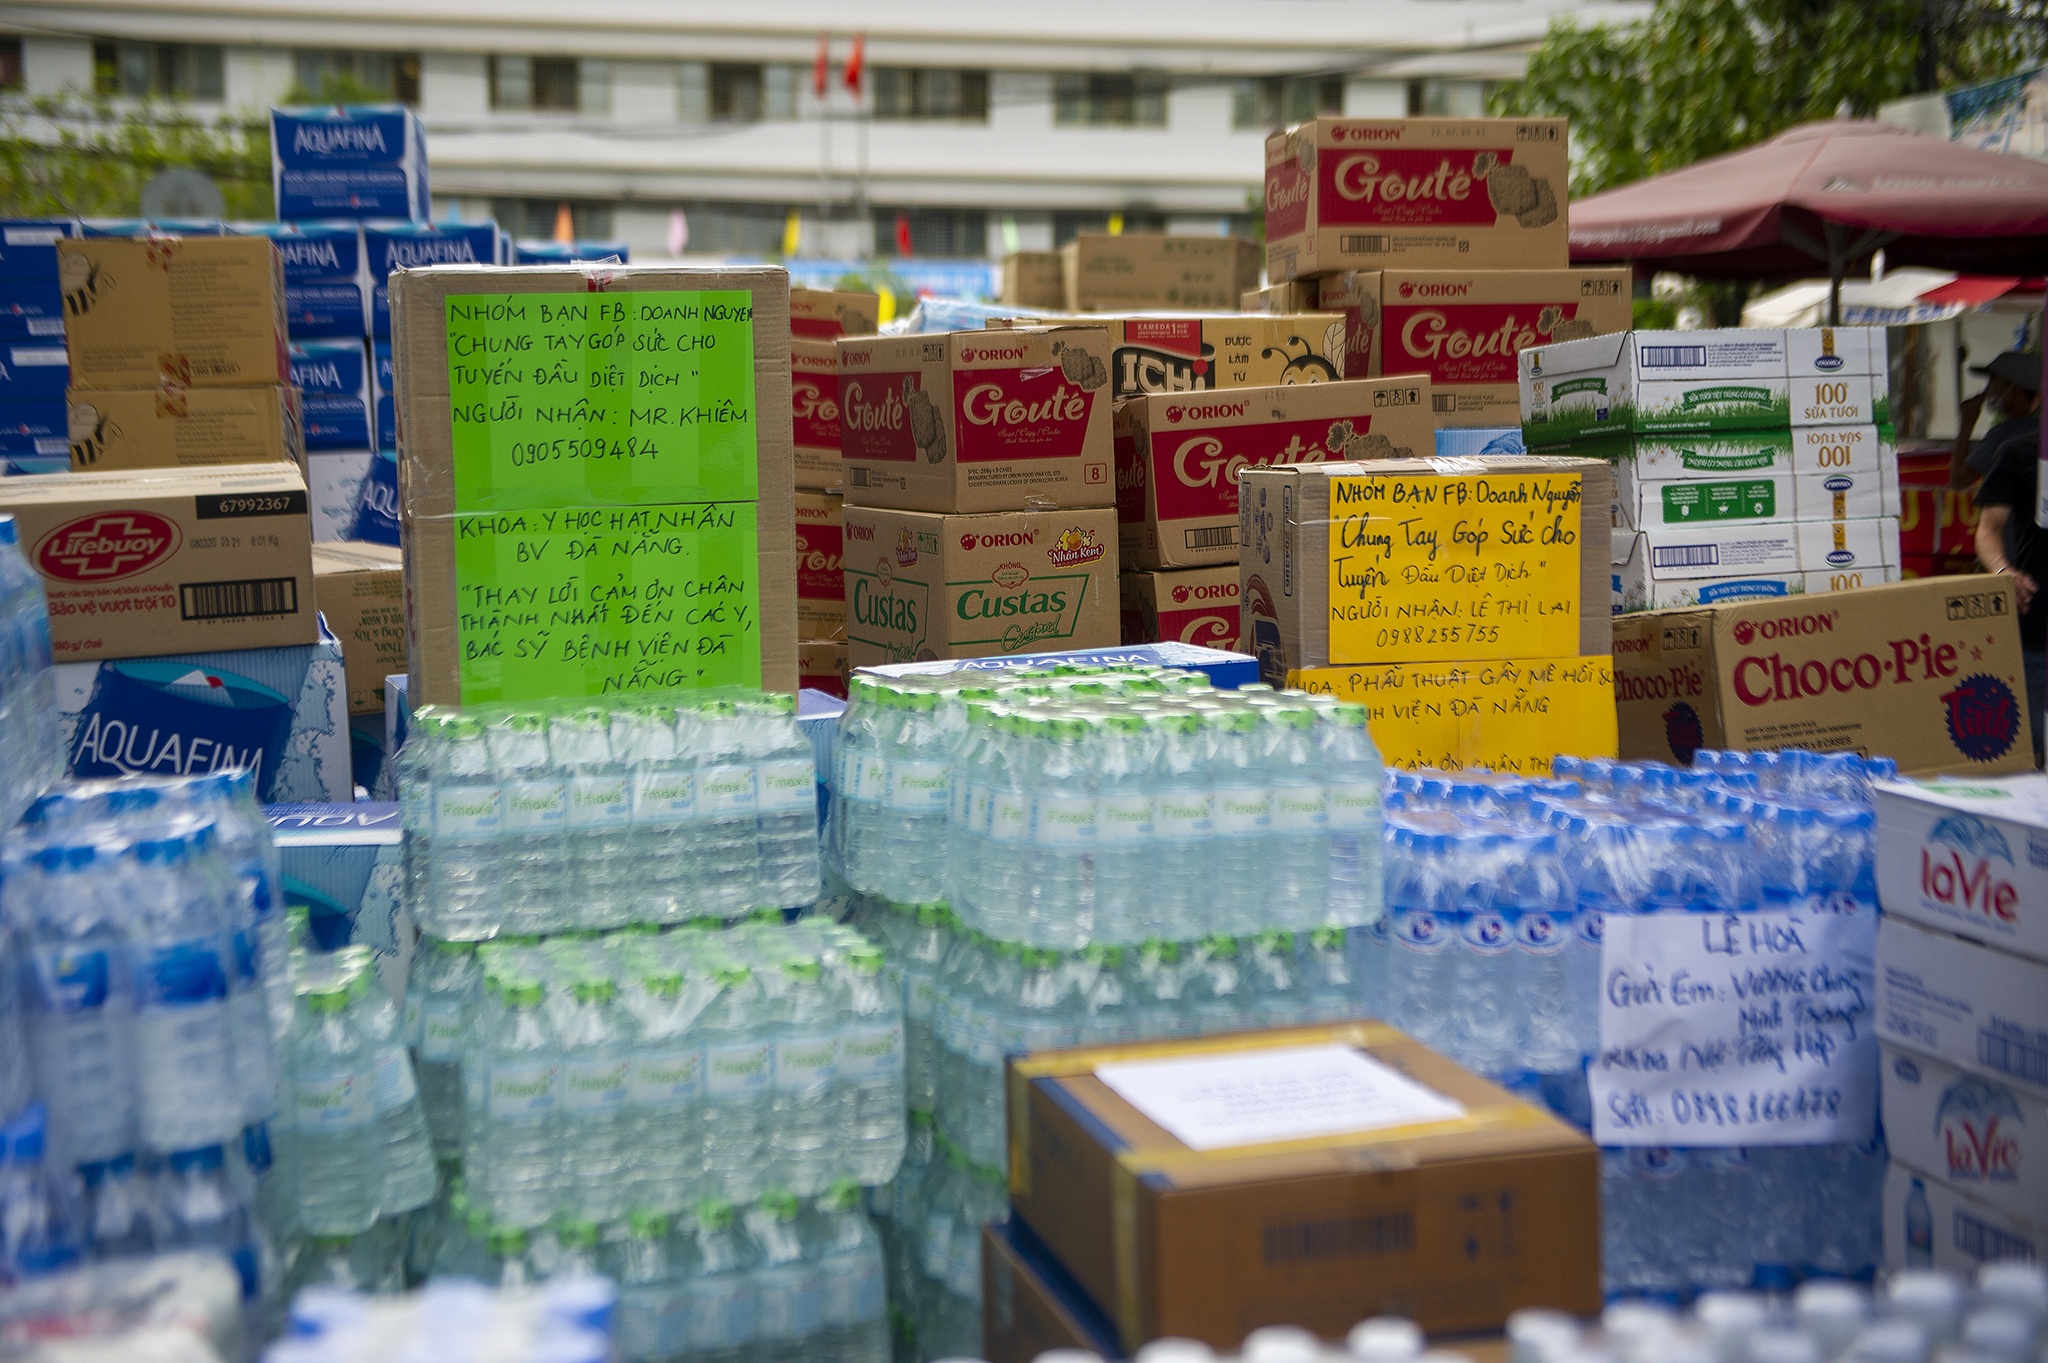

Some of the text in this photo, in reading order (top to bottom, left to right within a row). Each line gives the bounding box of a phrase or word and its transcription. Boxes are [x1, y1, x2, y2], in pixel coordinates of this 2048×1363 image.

[294, 123, 387, 155] AQUAFINA
[1351, 128, 1399, 141] ORION
[1335, 155, 1472, 204] Gouté
[1266, 177, 1308, 213] Gouté
[1418, 284, 1467, 297] ORION
[450, 295, 526, 323] NHÓM
[541, 304, 588, 327] BẠN
[641, 305, 698, 321] DOANH
[544, 334, 583, 350] TAY
[588, 325, 626, 350] GÓP
[633, 328, 670, 352] SỨC
[677, 334, 716, 350] CHO
[1225, 336, 1252, 348] ĐƯỢC
[1402, 311, 1536, 360] Gouté
[849, 351, 872, 365] ORION
[979, 348, 1024, 361] ORION
[1228, 352, 1249, 364] LÀM
[453, 358, 523, 385] TUYẾN
[533, 359, 578, 385] ĐẦU
[590, 365, 625, 392] DIỆT
[1233, 371, 1247, 382] TỪ
[680, 399, 748, 427] KHIÊM
[845, 382, 904, 432] Gouté
[963, 383, 1085, 427] Gouté
[1188, 402, 1244, 420] ORION
[1805, 405, 1859, 419] SỮA TƯƠI
[1807, 431, 1862, 445] SỮA TƯƠI
[511, 437, 660, 467] 0905509484
[218, 497, 291, 514] 67992367
[1393, 483, 1439, 510] BẠN
[1476, 481, 1528, 504] Doanh
[1533, 479, 1583, 514] Nguyễn
[542, 511, 558, 531] Y
[564, 511, 603, 535] HỌC
[610, 511, 650, 535] HẠT
[659, 503, 735, 530] NHÂN
[48, 535, 165, 558] Lifebuoy
[854, 526, 875, 542] ORION
[981, 532, 1034, 548] ORION
[1397, 517, 1441, 560] Tay
[1452, 519, 1490, 557] Góp
[1500, 511, 1535, 545] Sức
[516, 540, 552, 563] BV
[1826, 553, 1854, 562] VINAMILK
[590, 573, 638, 603] CẢM
[684, 575, 745, 599] CHÂN
[1333, 554, 1391, 600] Tuyến
[1401, 563, 1440, 585] Đầu
[1446, 566, 1488, 588] Diệt
[160, 594, 176, 608] 10
[957, 589, 1067, 621] Custas
[1194, 583, 1240, 600] ORIO
[460, 603, 539, 631] THÀNH
[620, 600, 674, 624] ĐẾN
[685, 601, 728, 625] CÁC
[855, 578, 917, 634] Custas
[1332, 596, 1390, 621] NGƯỜI
[1471, 598, 1493, 619] LÊ
[1496, 593, 1532, 622] THỊ
[1538, 600, 1571, 616] LAI
[1377, 623, 1501, 648] 0988255755
[1760, 613, 1835, 640] ORION
[466, 629, 504, 661] BÁC
[561, 633, 630, 667] BỆNH
[1349, 665, 1405, 693] PHẪU
[1412, 668, 1470, 690] THUẬT
[1479, 661, 1522, 686] GÂY
[1529, 663, 1557, 686] MÊ
[1562, 662, 1595, 684] HỒI
[1393, 699, 1441, 725] VIỆN
[1492, 687, 1550, 715] NẴNG
[1393, 749, 1433, 772] CẢM
